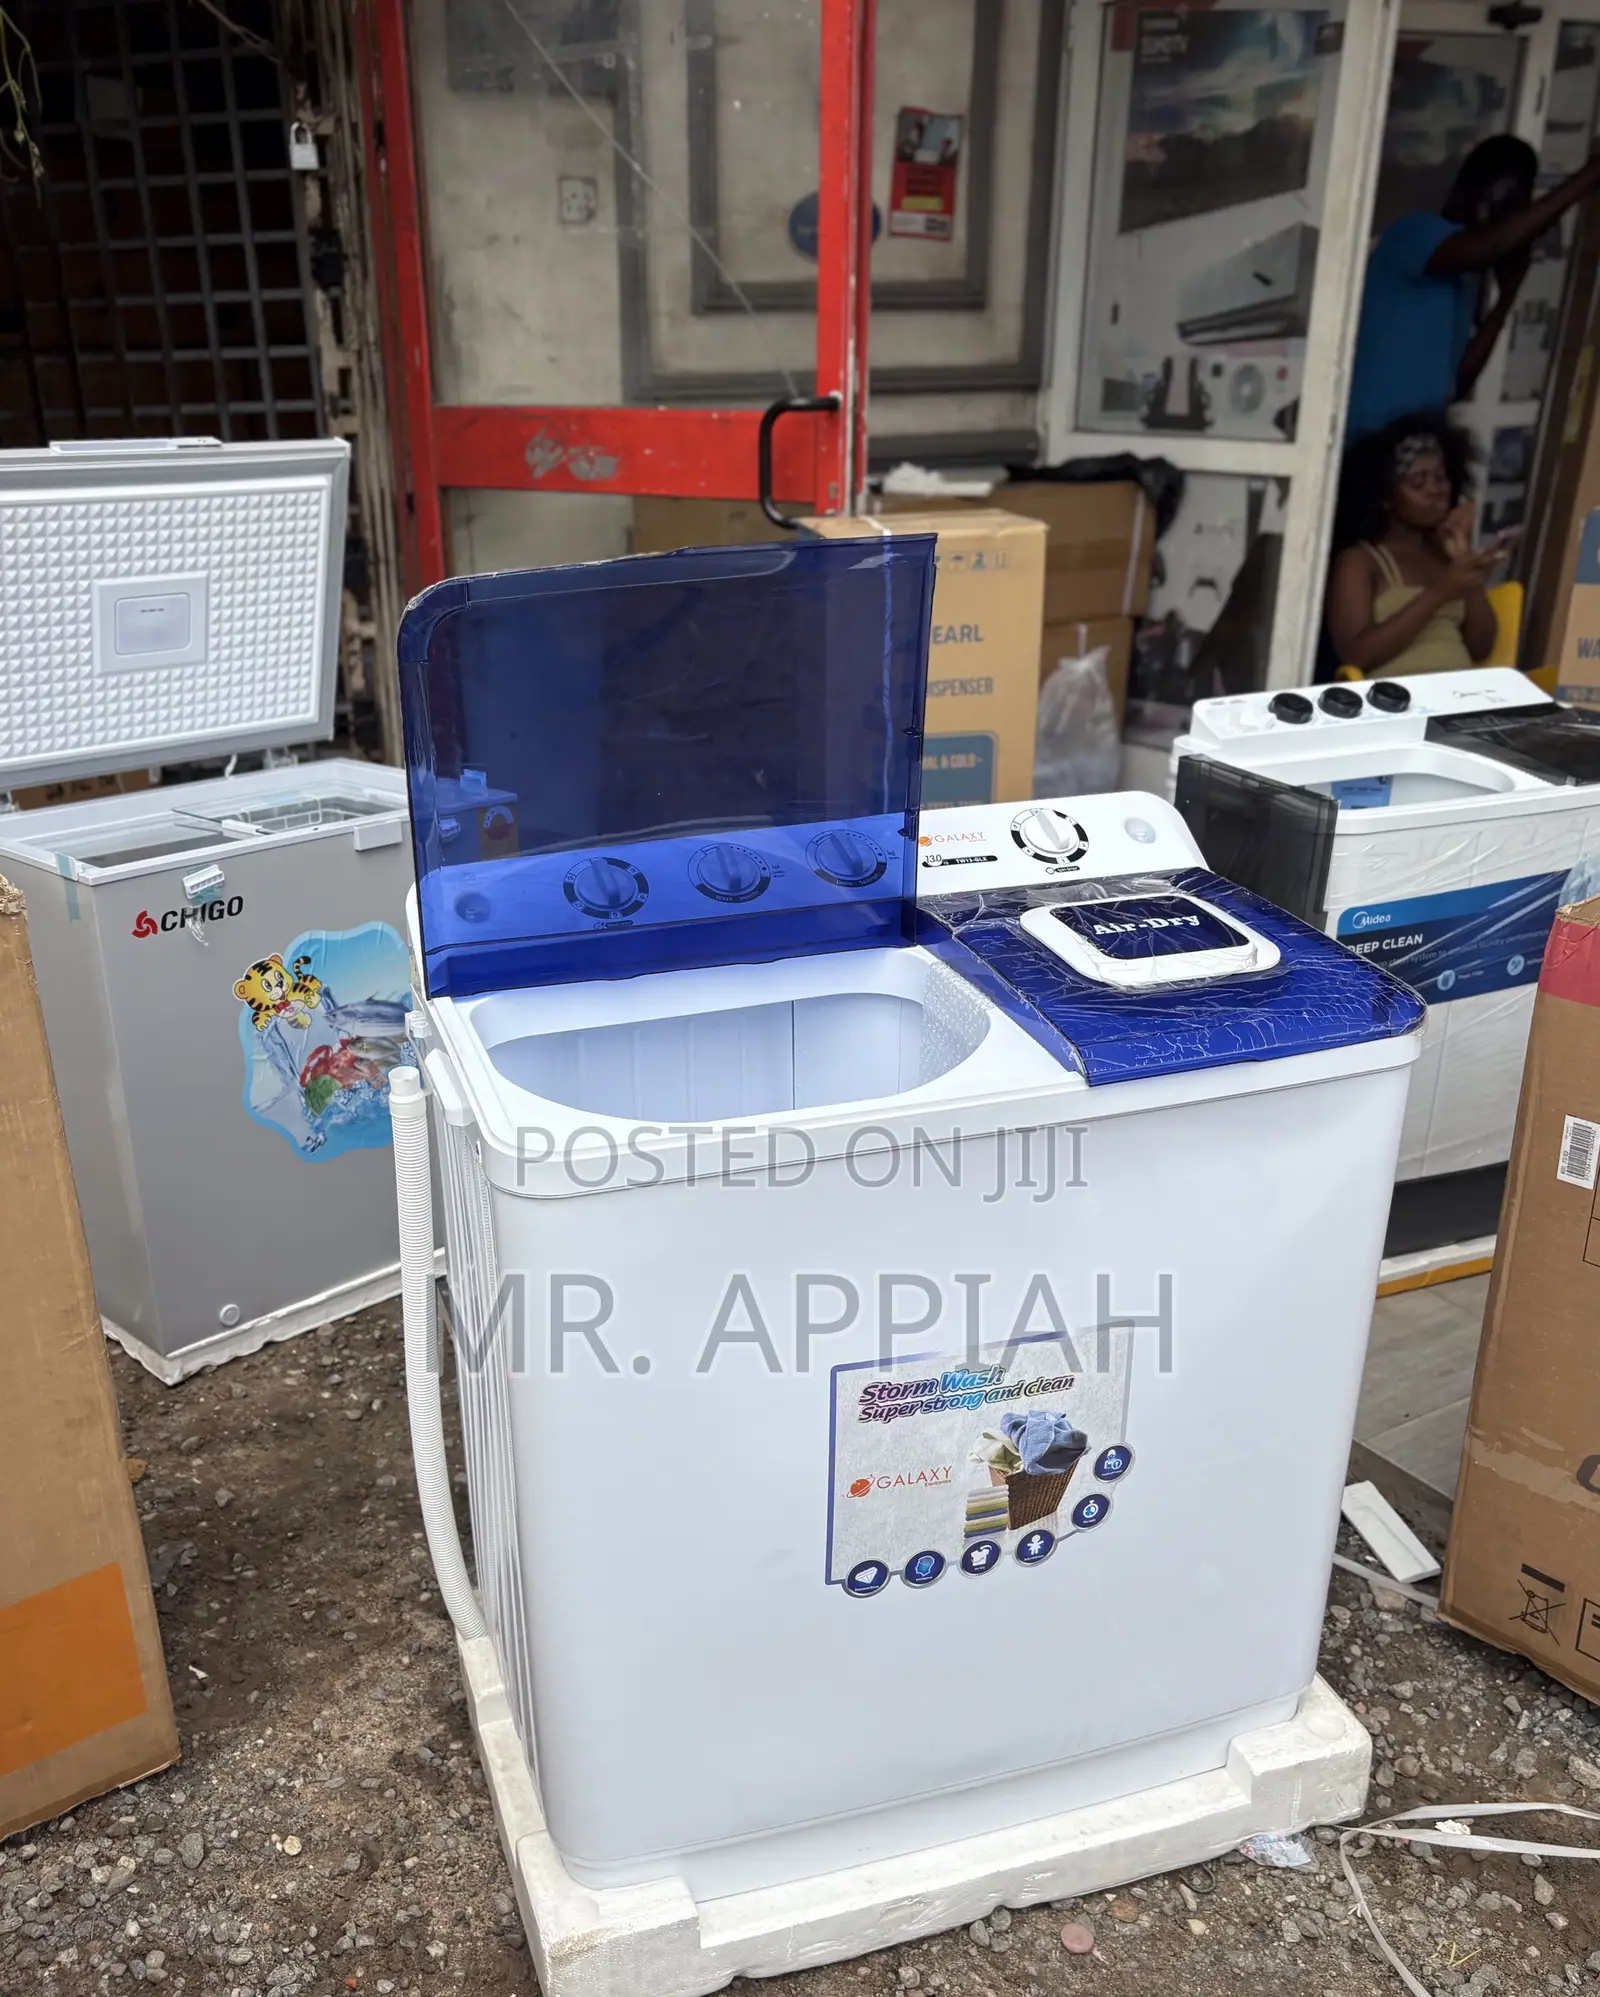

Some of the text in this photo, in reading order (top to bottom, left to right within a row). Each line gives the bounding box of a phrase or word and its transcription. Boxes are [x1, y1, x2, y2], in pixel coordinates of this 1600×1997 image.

[926, 677, 994, 698] ISPENSER
[934, 831, 984, 843] GALAXY
[160, 896, 244, 932] CHIGO
[1352, 911, 1391, 929] Midea
[1093, 915, 1200, 935] Air-Dry
[1382, 933, 1424, 950] CLEAN
[859, 1364, 1006, 1405] Storm Wash
[858, 1374, 1076, 1423] Super strong and clean
[876, 1465, 952, 1490] GALAXY
